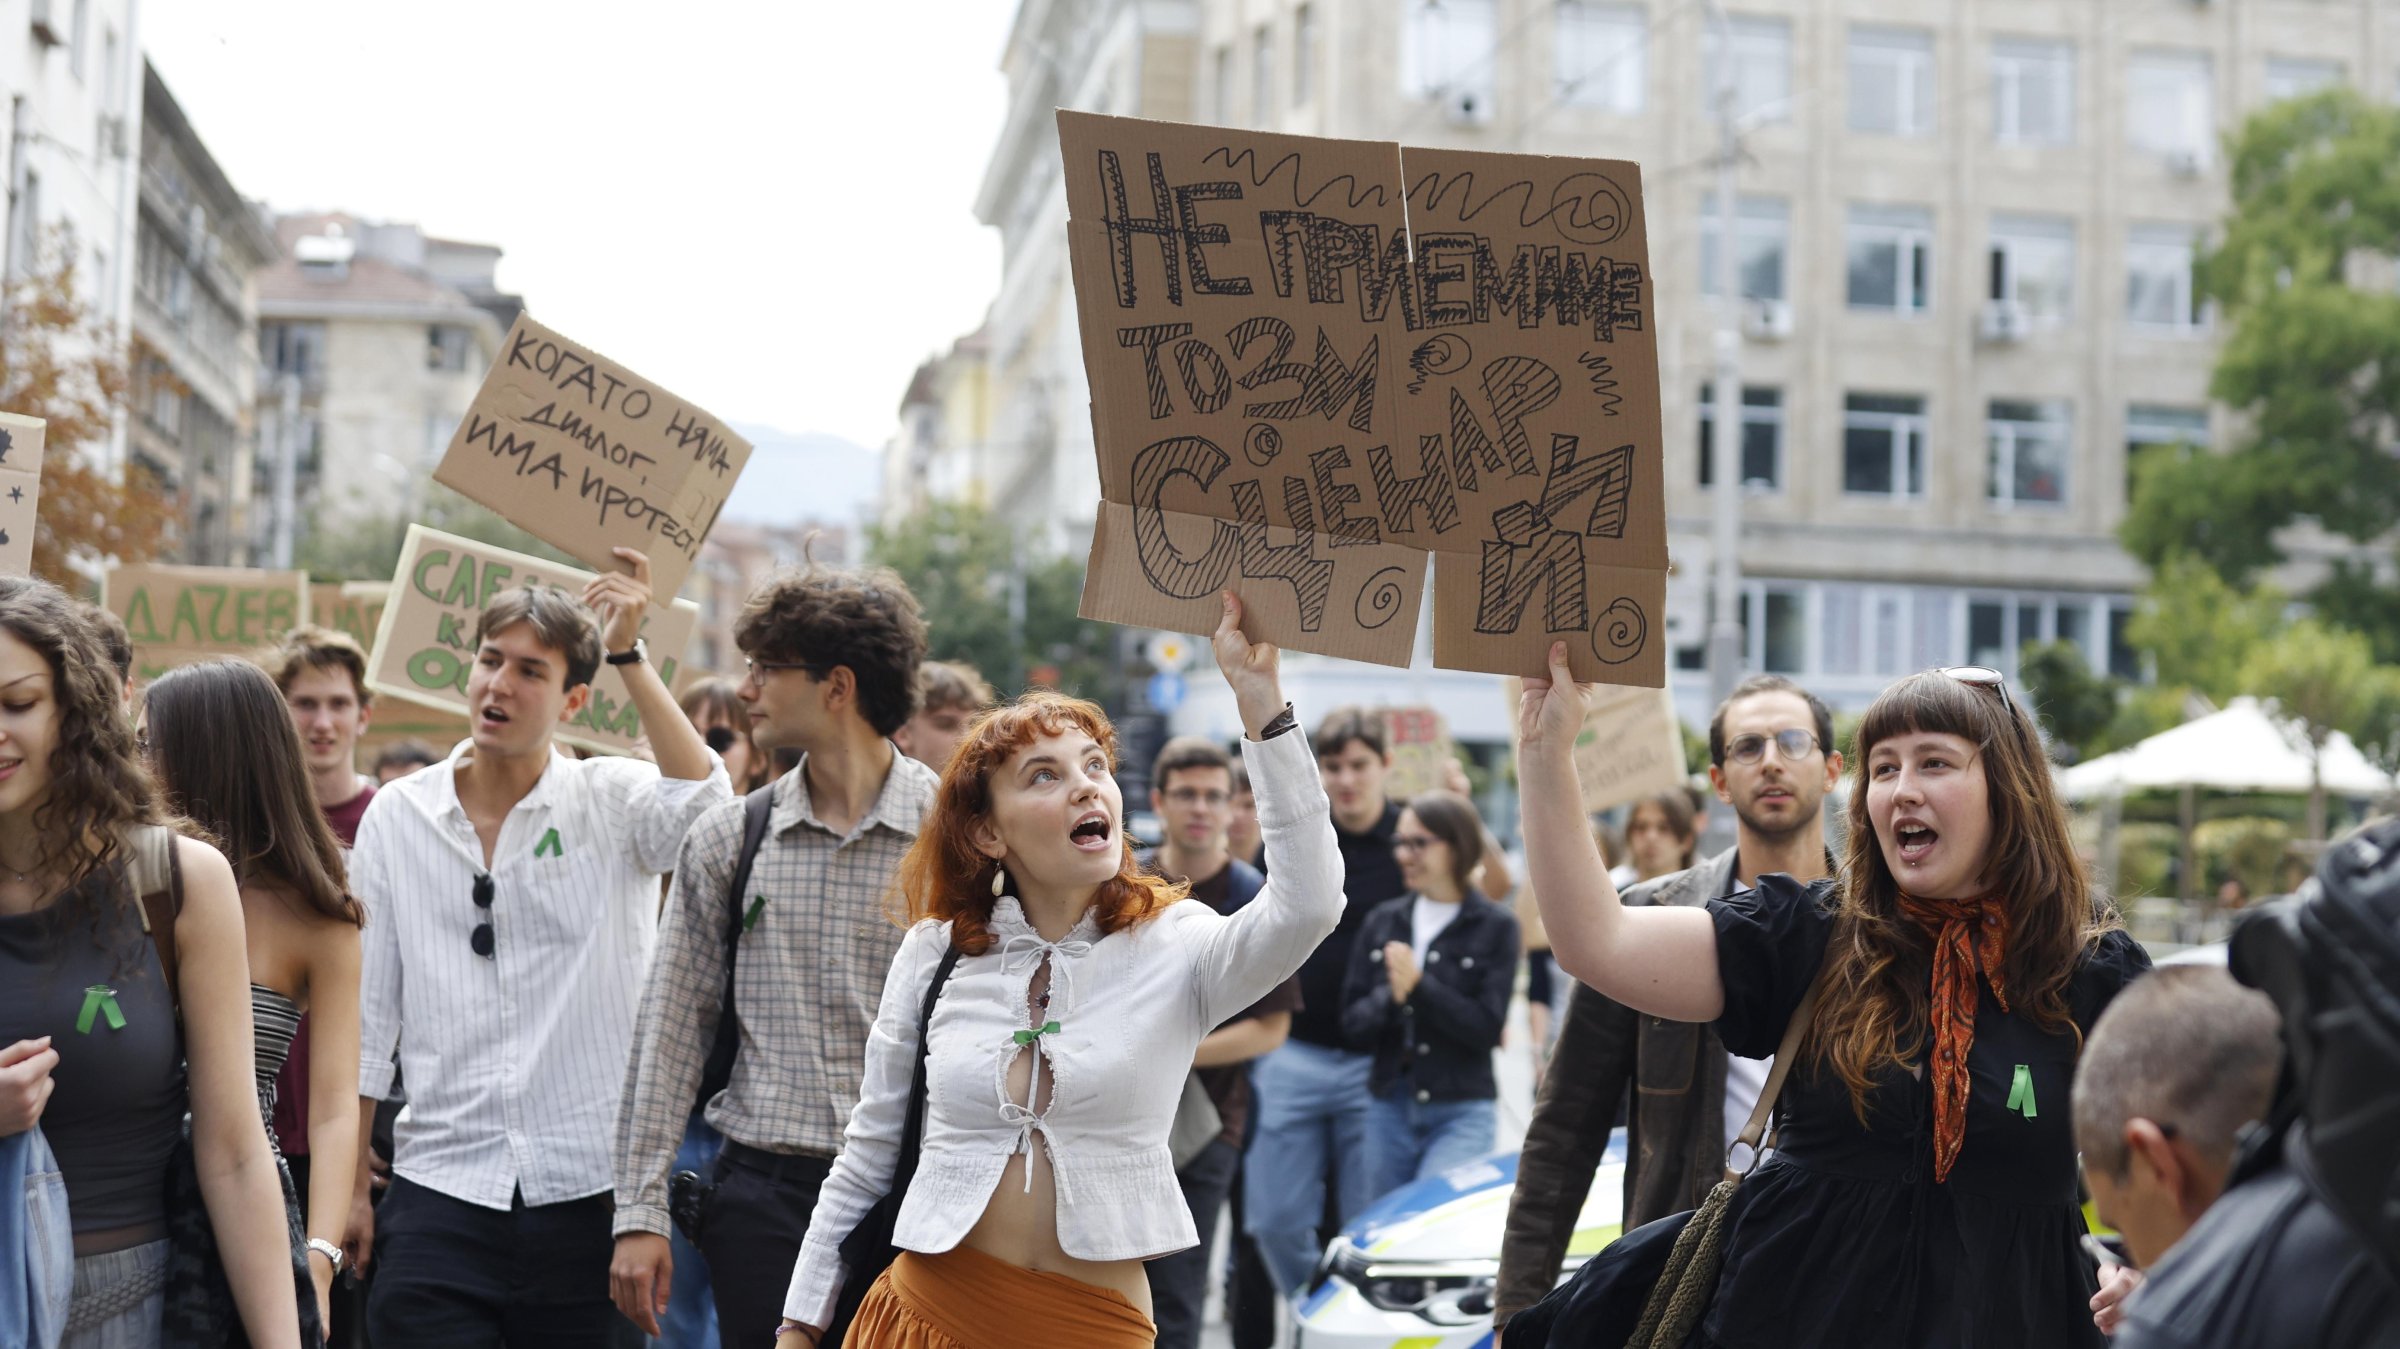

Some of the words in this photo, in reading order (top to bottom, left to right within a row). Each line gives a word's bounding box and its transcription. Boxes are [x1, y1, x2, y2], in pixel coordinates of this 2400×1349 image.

[1098, 148, 1254, 309] НЕ
[507, 328, 652, 420] КОГАТО
[664, 407, 731, 479] НЯМА
[1116, 316, 1379, 434] ТОЗИ
[465, 413, 569, 491] ИМА
